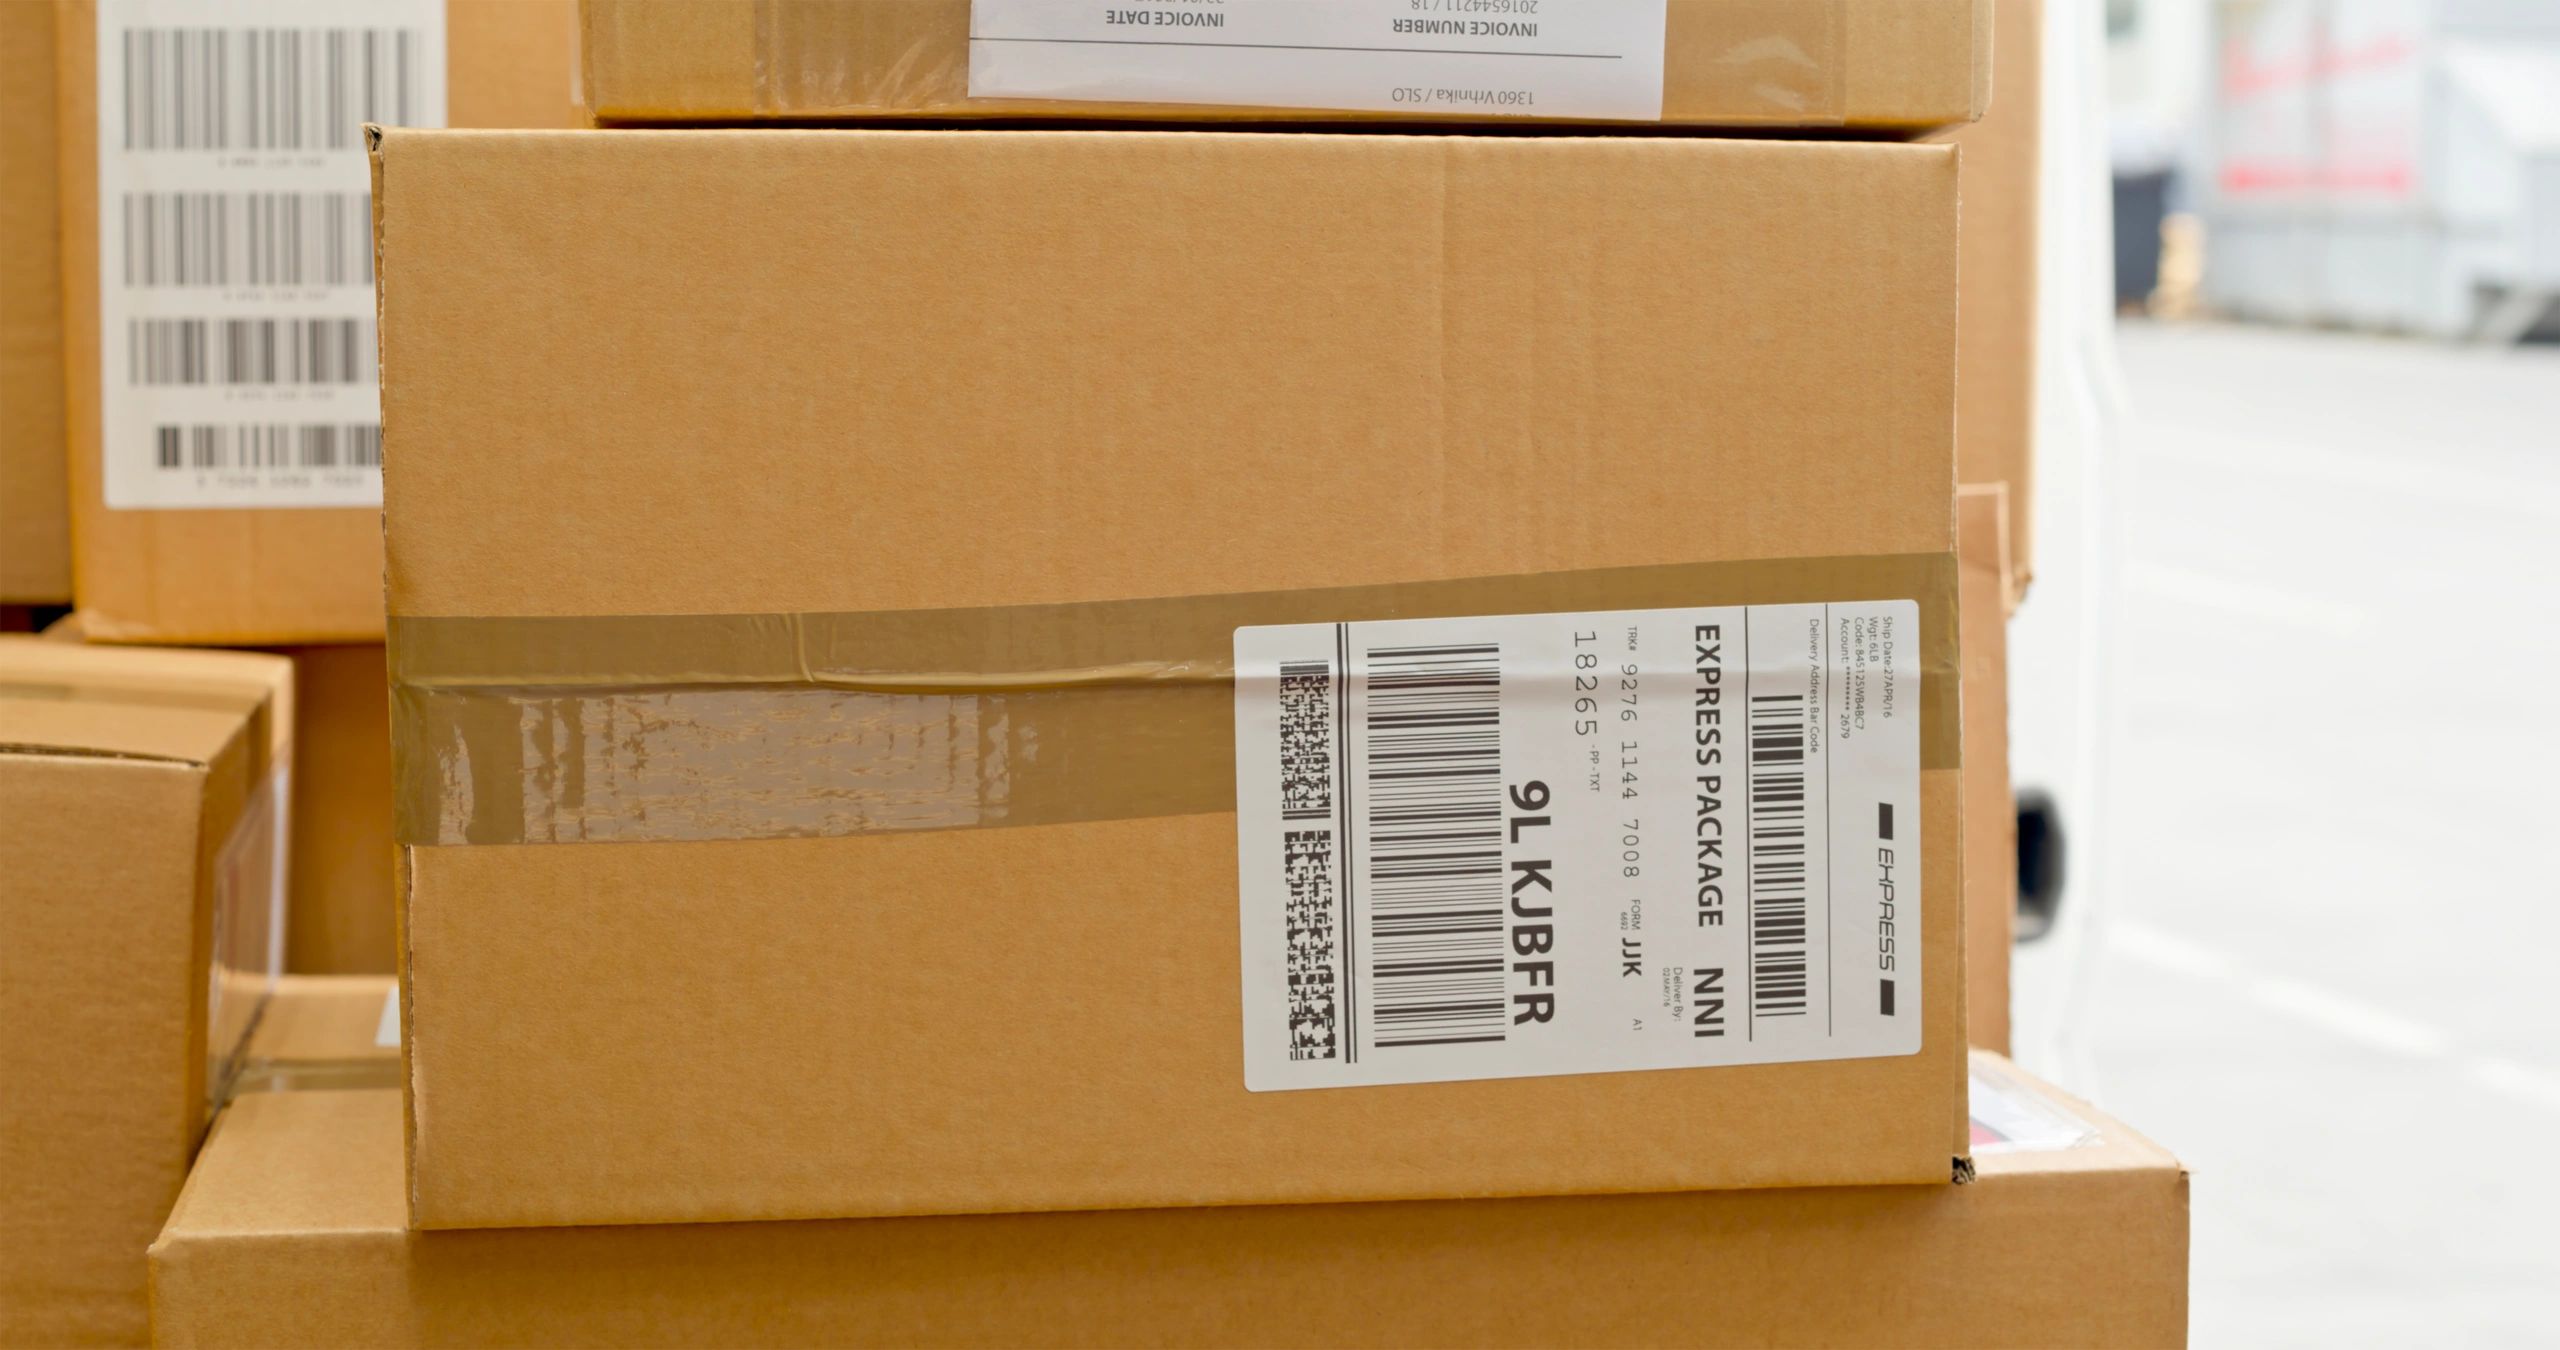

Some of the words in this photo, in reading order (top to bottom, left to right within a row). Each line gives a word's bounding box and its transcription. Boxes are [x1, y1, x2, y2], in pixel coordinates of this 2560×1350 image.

[1106, 10, 1150, 25] DATE
[1154, 12, 1224, 27] INVOICE
[1392, 19, 1465, 35] NUMBER
[1470, 21, 1538, 37] INVOICE
[1392, 88, 1422, 102] SLO
[1436, 89, 1495, 104] Vrhnika
[1498, 91, 1534, 105] 1360
[1627, 626, 1637, 651] TRK#
[1808, 619, 1820, 661] Delivery
[1840, 618, 1849, 664] Account:
[1855, 617, 1864, 647] Code:
[1868, 616, 1878, 641] Wgt:
[1882, 616, 1893, 639] Ship
[1869, 643, 1878, 662] 6LB
[1575, 631, 1598, 737] 18265
[1621, 664, 1638, 722] 9276
[1696, 624, 1721, 766] EXPRESS
[1810, 664, 1819, 705] Address
[1810, 707, 1819, 723] Bar
[1840, 714, 1850, 739] 2679
[1810, 726, 1820, 753] Code
[1621, 741, 1638, 800] 1144
[1509, 781, 1551, 843] 9L
[1623, 818, 1639, 879] 7008
[1697, 776, 1722, 927] PACKAGE
[1631, 899, 1640, 930] FORM
[1878, 847, 1895, 972] EXPRESS
[1512, 861, 1554, 1025] KJBFR
[1622, 938, 1641, 977] JJK
[1673, 967, 1683, 1003] Deliver
[1672, 1006, 1684, 1022] By:
[1693, 967, 1725, 1038] NNI
[1631, 1020, 1643, 1030] A1
